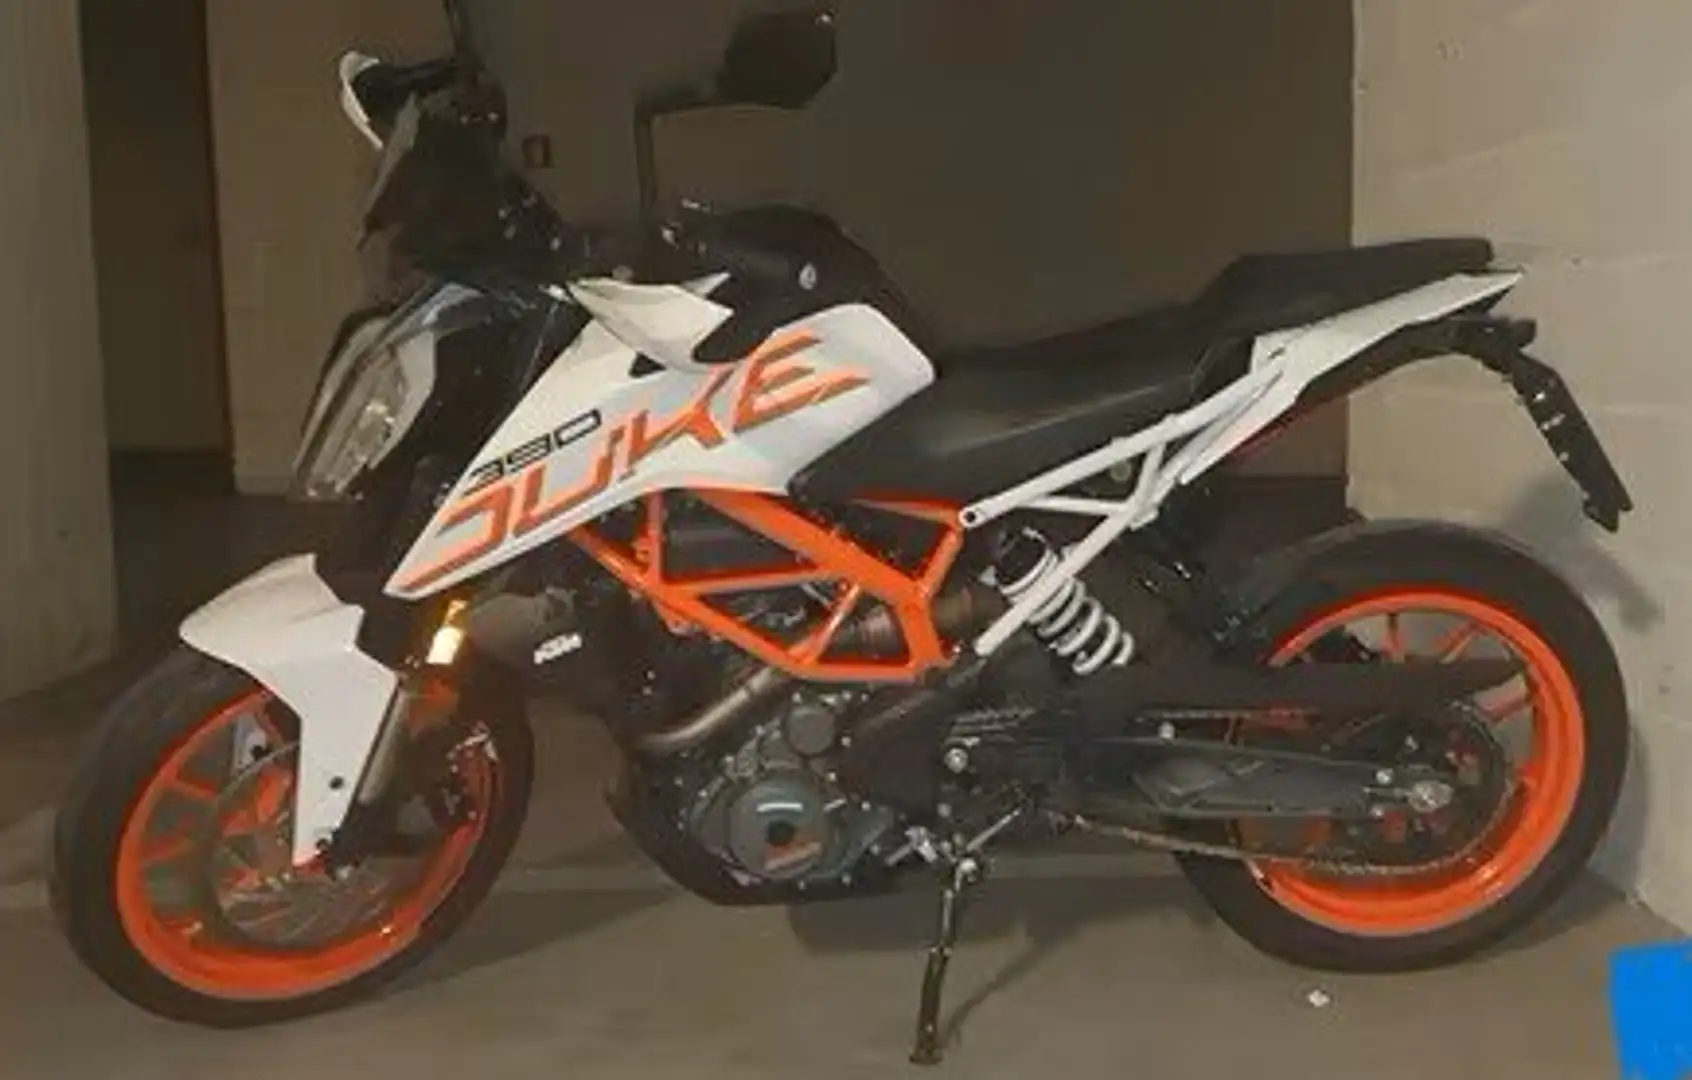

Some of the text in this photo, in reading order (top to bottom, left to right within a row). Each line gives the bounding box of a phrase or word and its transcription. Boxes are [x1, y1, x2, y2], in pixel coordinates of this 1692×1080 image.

[399, 328, 870, 591] DUKE
[465, 408, 602, 495] 390
[534, 634, 582, 664] KTM
